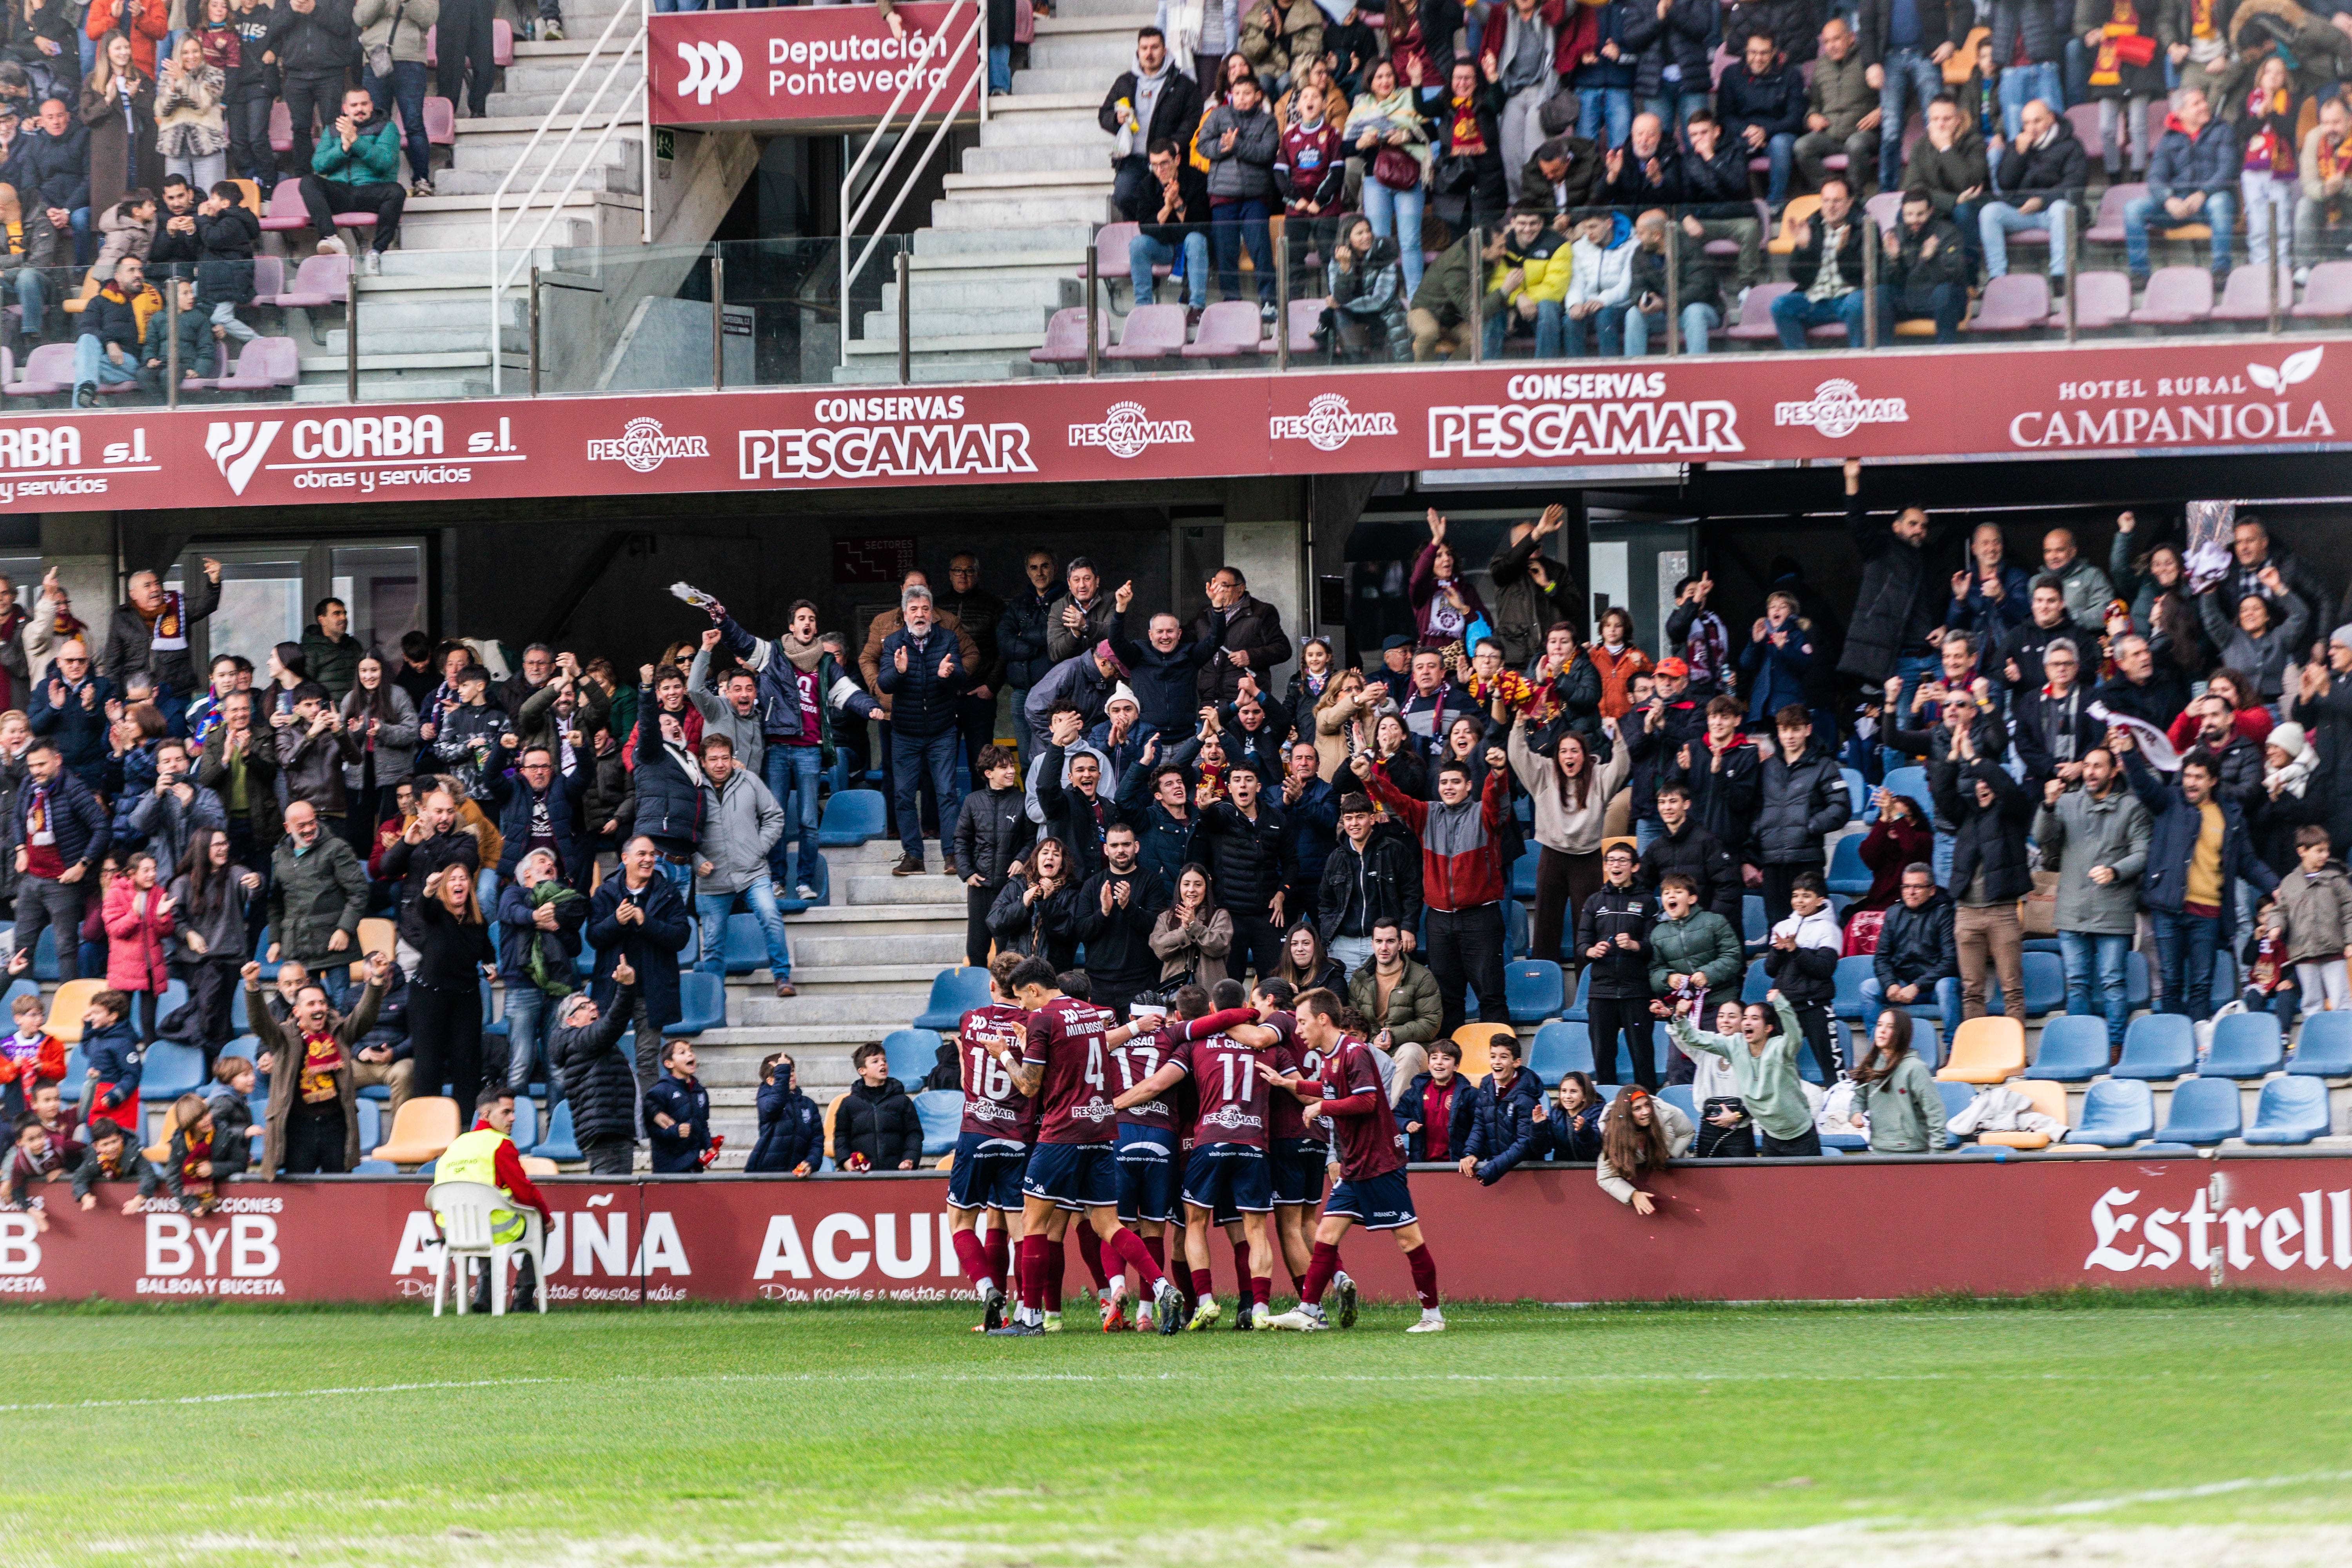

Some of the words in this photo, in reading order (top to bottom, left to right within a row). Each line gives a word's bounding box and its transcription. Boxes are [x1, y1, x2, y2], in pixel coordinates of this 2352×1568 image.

[769, 28, 947, 71] Deputación
[769, 62, 947, 96] Pontevedra
[1508, 372, 1666, 400] CONSERVAS
[2059, 378, 2147, 401] HOTEL
[2157, 374, 2247, 397] RURAL
[815, 395, 965, 423] CONSERVAS
[1775, 397, 1909, 426] PESCAMAR
[292, 414, 444, 459] CORBA
[468, 416, 517, 453] s.l.
[1069, 420, 1195, 446] PESCAMAR
[1270, 412, 1398, 439] PESCAMAR
[1428, 400, 1746, 458] PESCAMAR
[2009, 401, 2335, 448] CAMPANIOLA
[103, 428, 152, 464] s.l.
[587, 436, 710, 461] PESCAMAR
[739, 423, 1038, 480] PESCAMAR
[16, 476, 108, 496] servicios
[293, 469, 356, 489] obras
[360, 471, 375, 493] y
[379, 465, 472, 486] servicios
[865, 540, 913, 549] SECTORES
[897, 550, 913, 558] 233
[965, 1029, 974, 1040] A.
[1065, 1023, 1086, 1037] MIKI
[1206, 1039, 1222, 1049] M.
[969, 1047, 1012, 1100] 16
[1084, 1037, 1105, 1091] 4
[1110, 1047, 1160, 1089] 17
[1216, 1053, 1254, 1102] 11
[1202, 1112, 1263, 1129] PESCAMAR
[2083, 1186, 2352, 1272] Estrell
[136, 1278, 204, 1294] BALBOA
[219, 1279, 285, 1295] BUCETA
[582, 1286, 642, 1301] cousas
